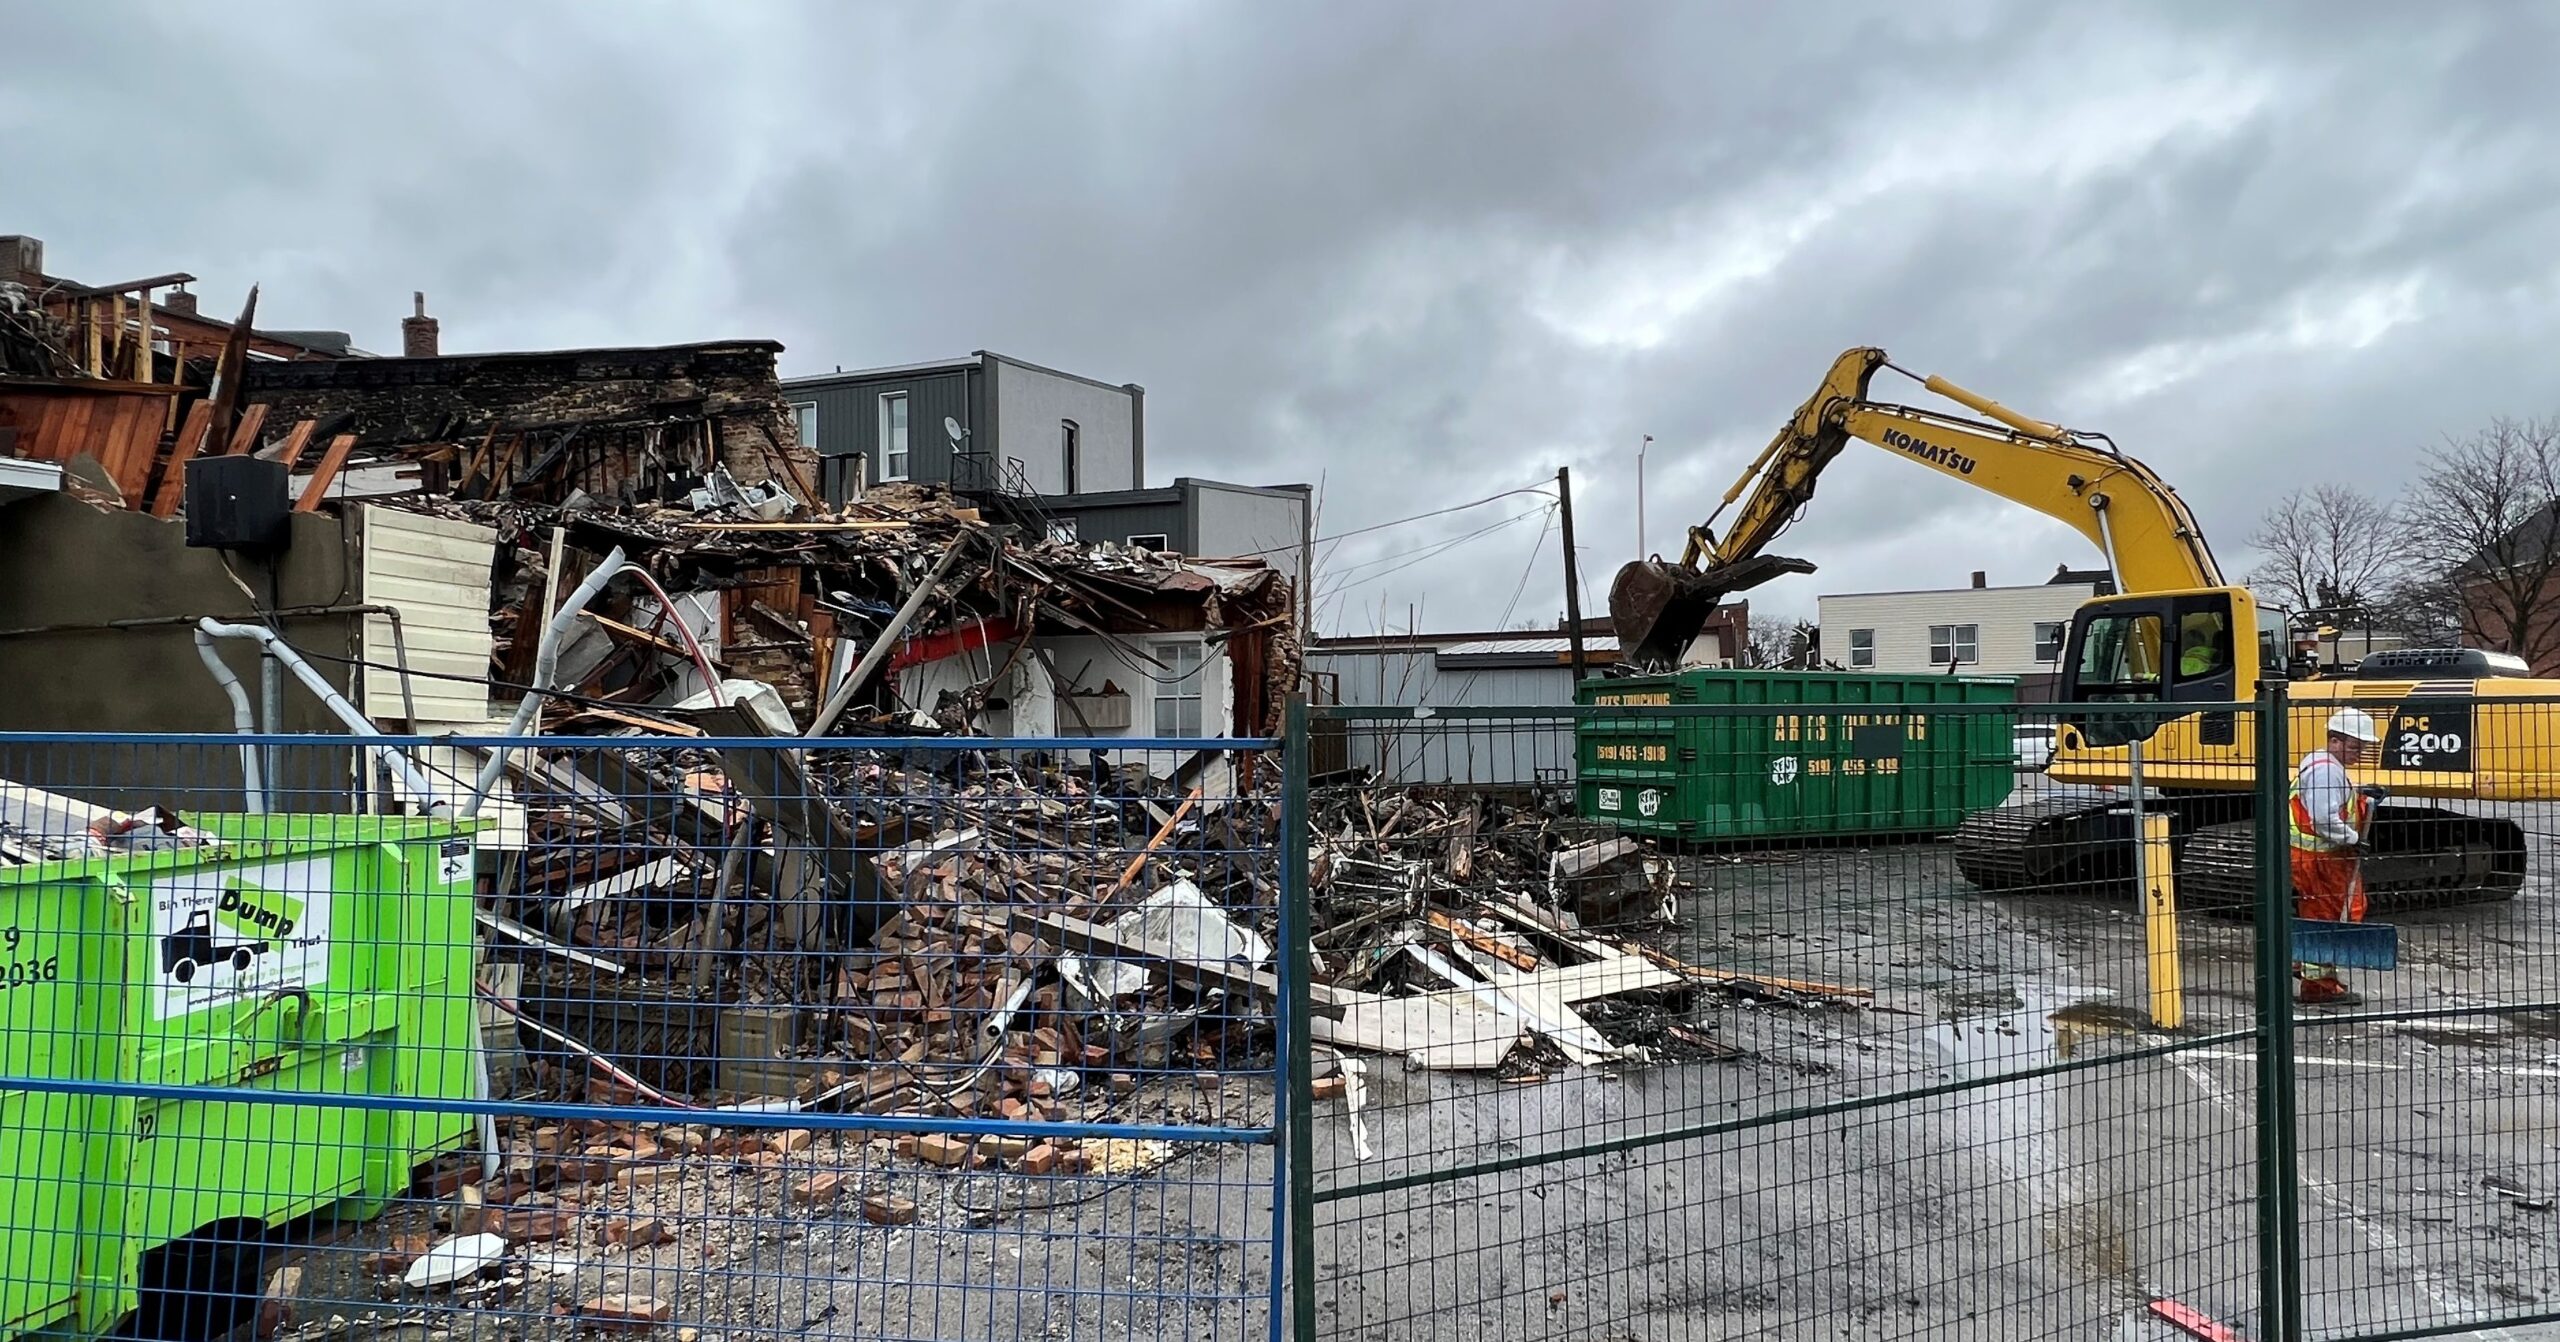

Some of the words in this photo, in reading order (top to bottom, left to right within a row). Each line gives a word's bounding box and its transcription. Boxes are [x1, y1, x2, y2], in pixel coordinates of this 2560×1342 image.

[1882, 427, 1976, 475] KOMATSU
[2400, 716, 2429, 731] PC
[2400, 733, 2461, 753] 200
[2401, 754, 2423, 766] LC
[159, 901, 178, 911] Bin
[182, 895, 214, 908] There
[219, 889, 294, 938] Dump
[5, 926, 20, 952] 9
[291, 935, 321, 949] That
